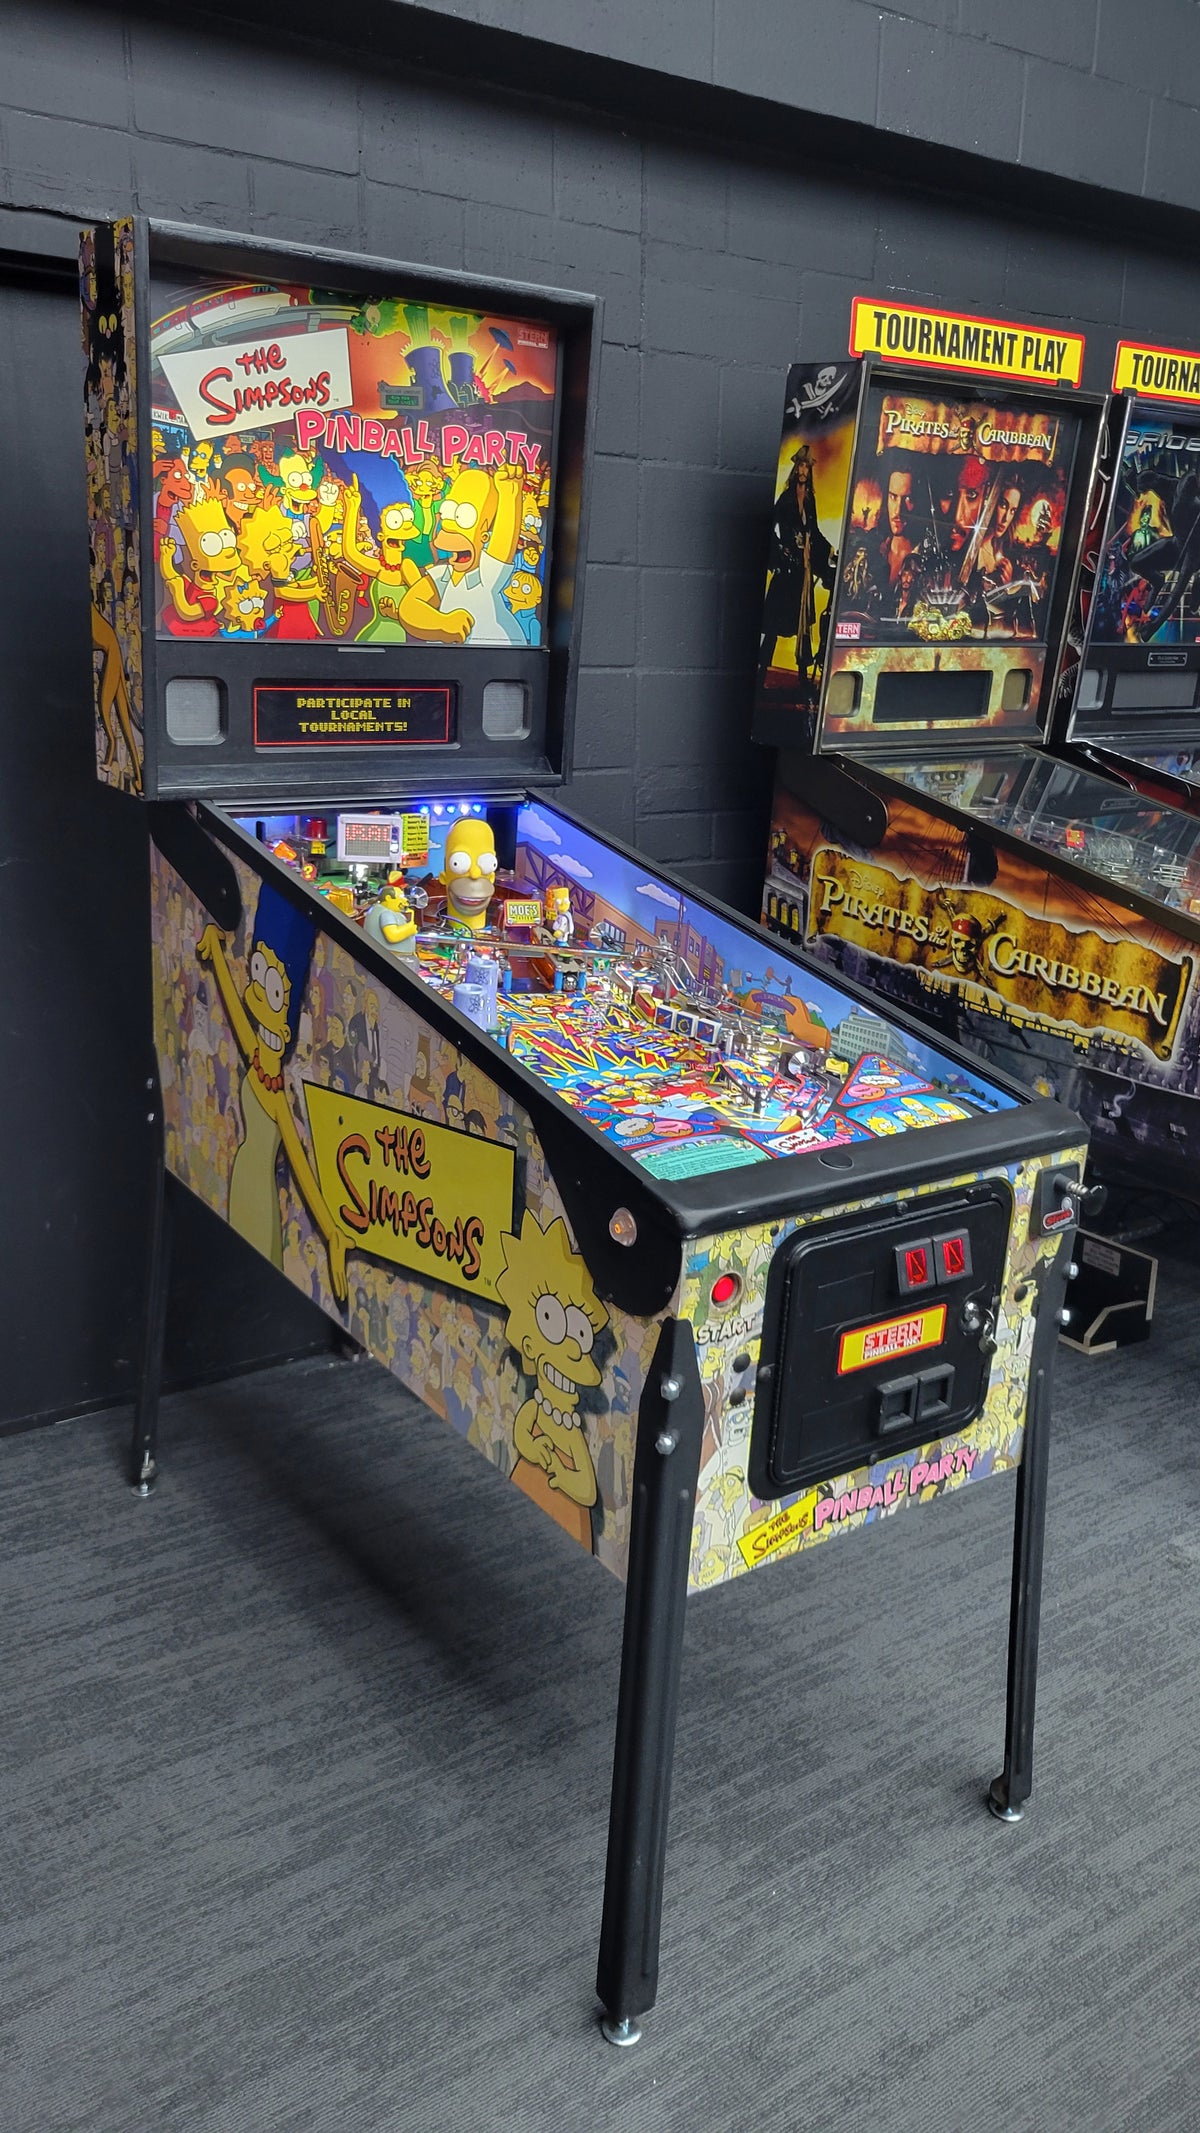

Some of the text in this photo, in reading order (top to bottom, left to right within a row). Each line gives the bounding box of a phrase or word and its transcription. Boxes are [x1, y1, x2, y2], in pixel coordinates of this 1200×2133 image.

[873, 311, 1067, 375] TOURNAMENT PLAY
[294, 408, 542, 474] PINBALL PARTY
[884, 410, 949, 439] PIRATES
[978, 423, 1052, 450] CARIBBEAN
[296, 698, 411, 708] PARTICIPATE IN
[330, 710, 377, 720] LOCAL
[299, 722, 408, 733] TOURNAMENTS!
[509, 904, 538, 916] MOE'S
[817, 873, 929, 943] PIRATES
[987, 932, 1168, 1026] CARIBBEAN
[697, 1312, 757, 1346] START
[864, 1318, 923, 1349] STERN
[814, 1447, 978, 1533] PINBALL PARTY
